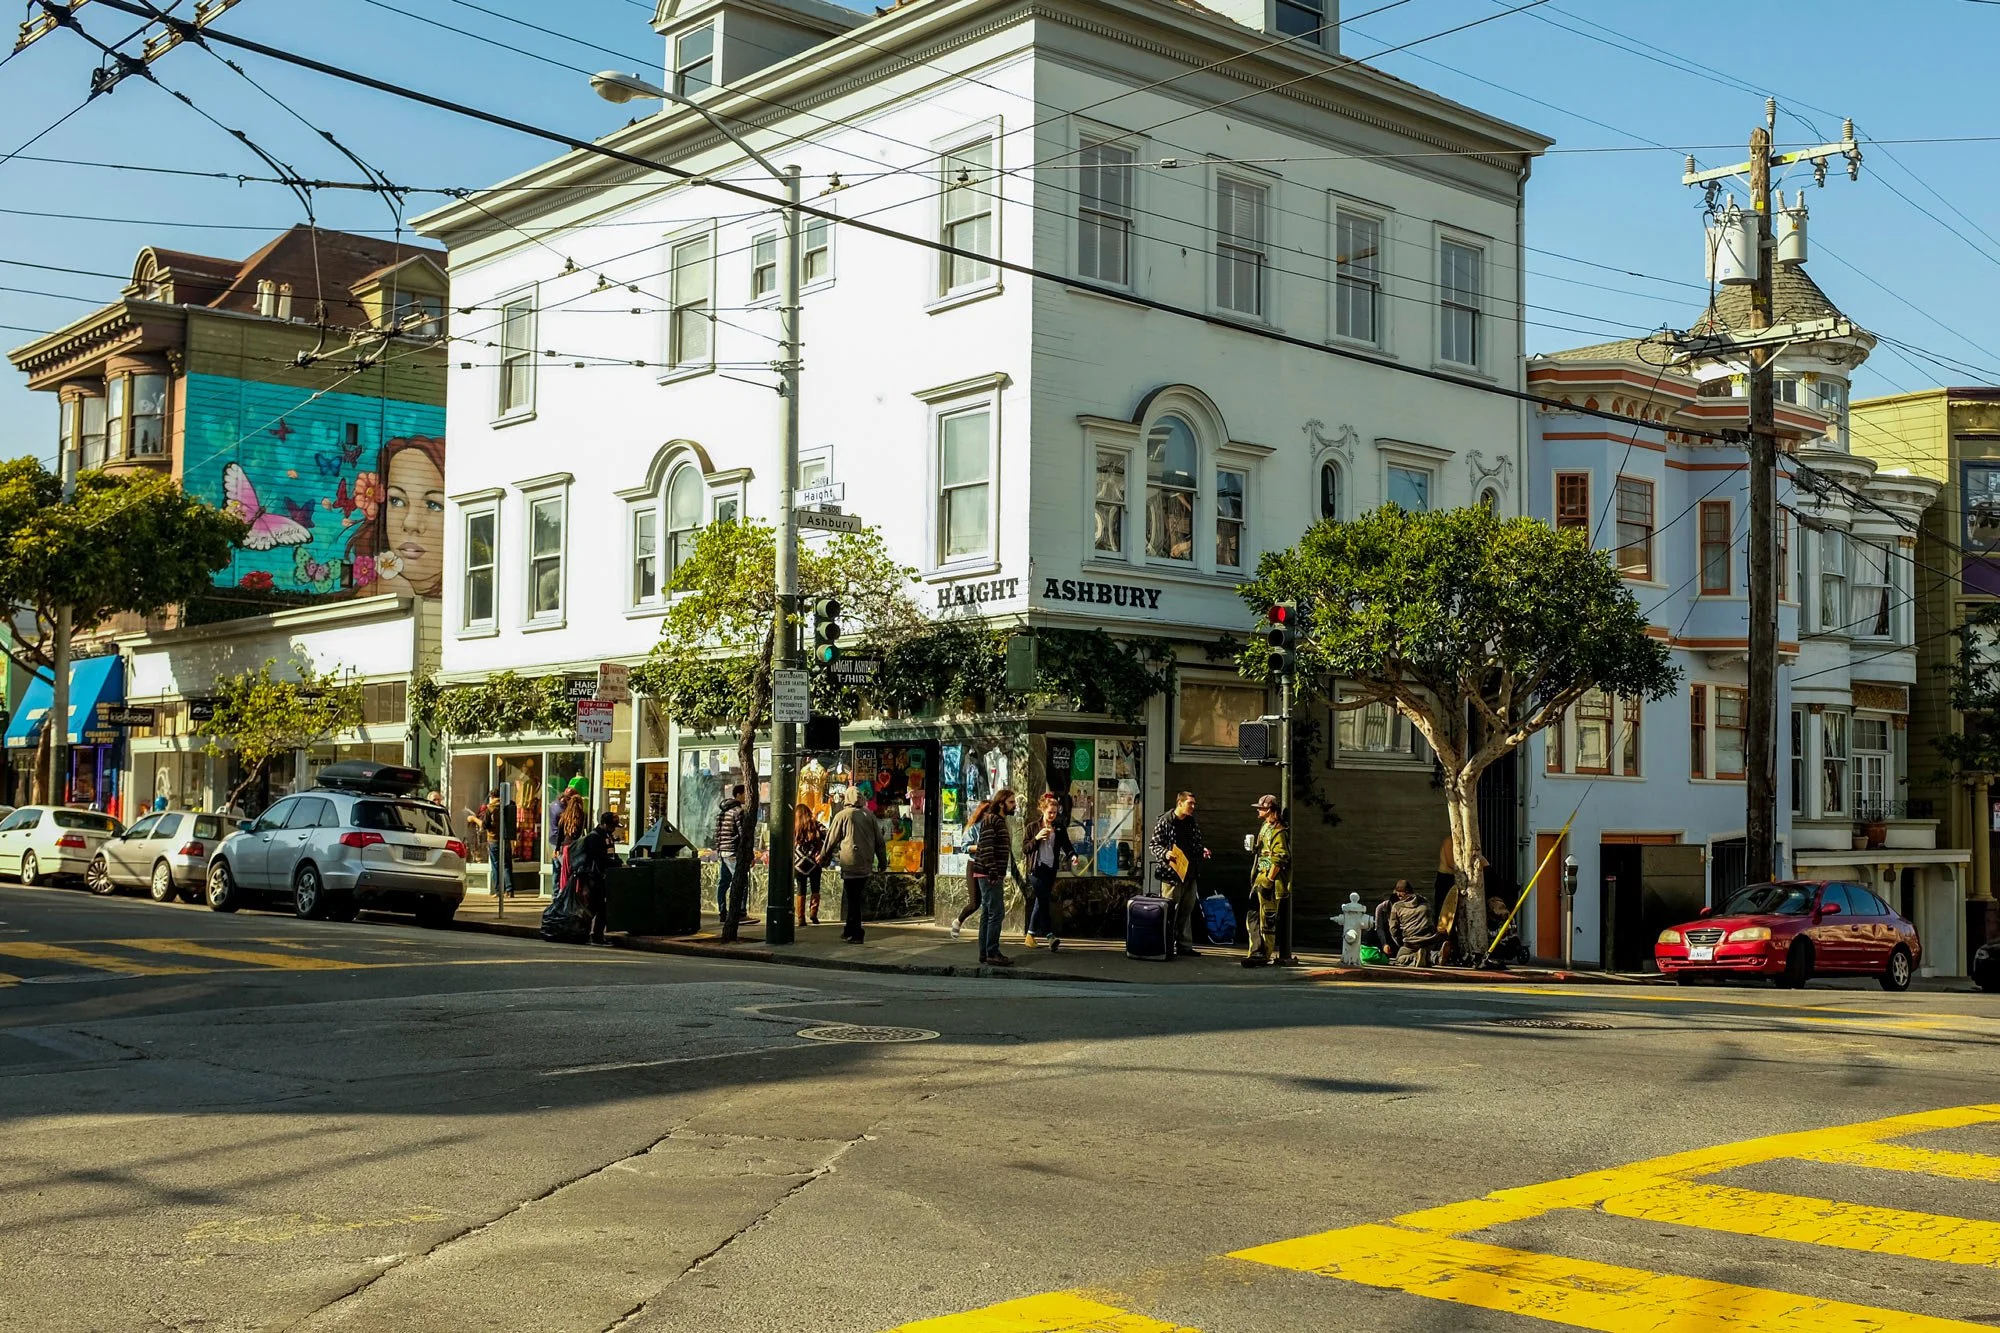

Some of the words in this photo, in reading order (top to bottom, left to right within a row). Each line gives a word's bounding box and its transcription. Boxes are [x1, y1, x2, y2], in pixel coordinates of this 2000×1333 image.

[804, 489, 833, 503] Haight
[827, 506, 840, 514] 600
[806, 515, 854, 531] Ashbury
[936, 577, 1019, 609] HAIGHT
[1042, 577, 1163, 610] ASHBURY
[574, 681, 597, 689] HAIG
[579, 707, 589, 715] NO
[856, 750, 875, 759] OPEN
